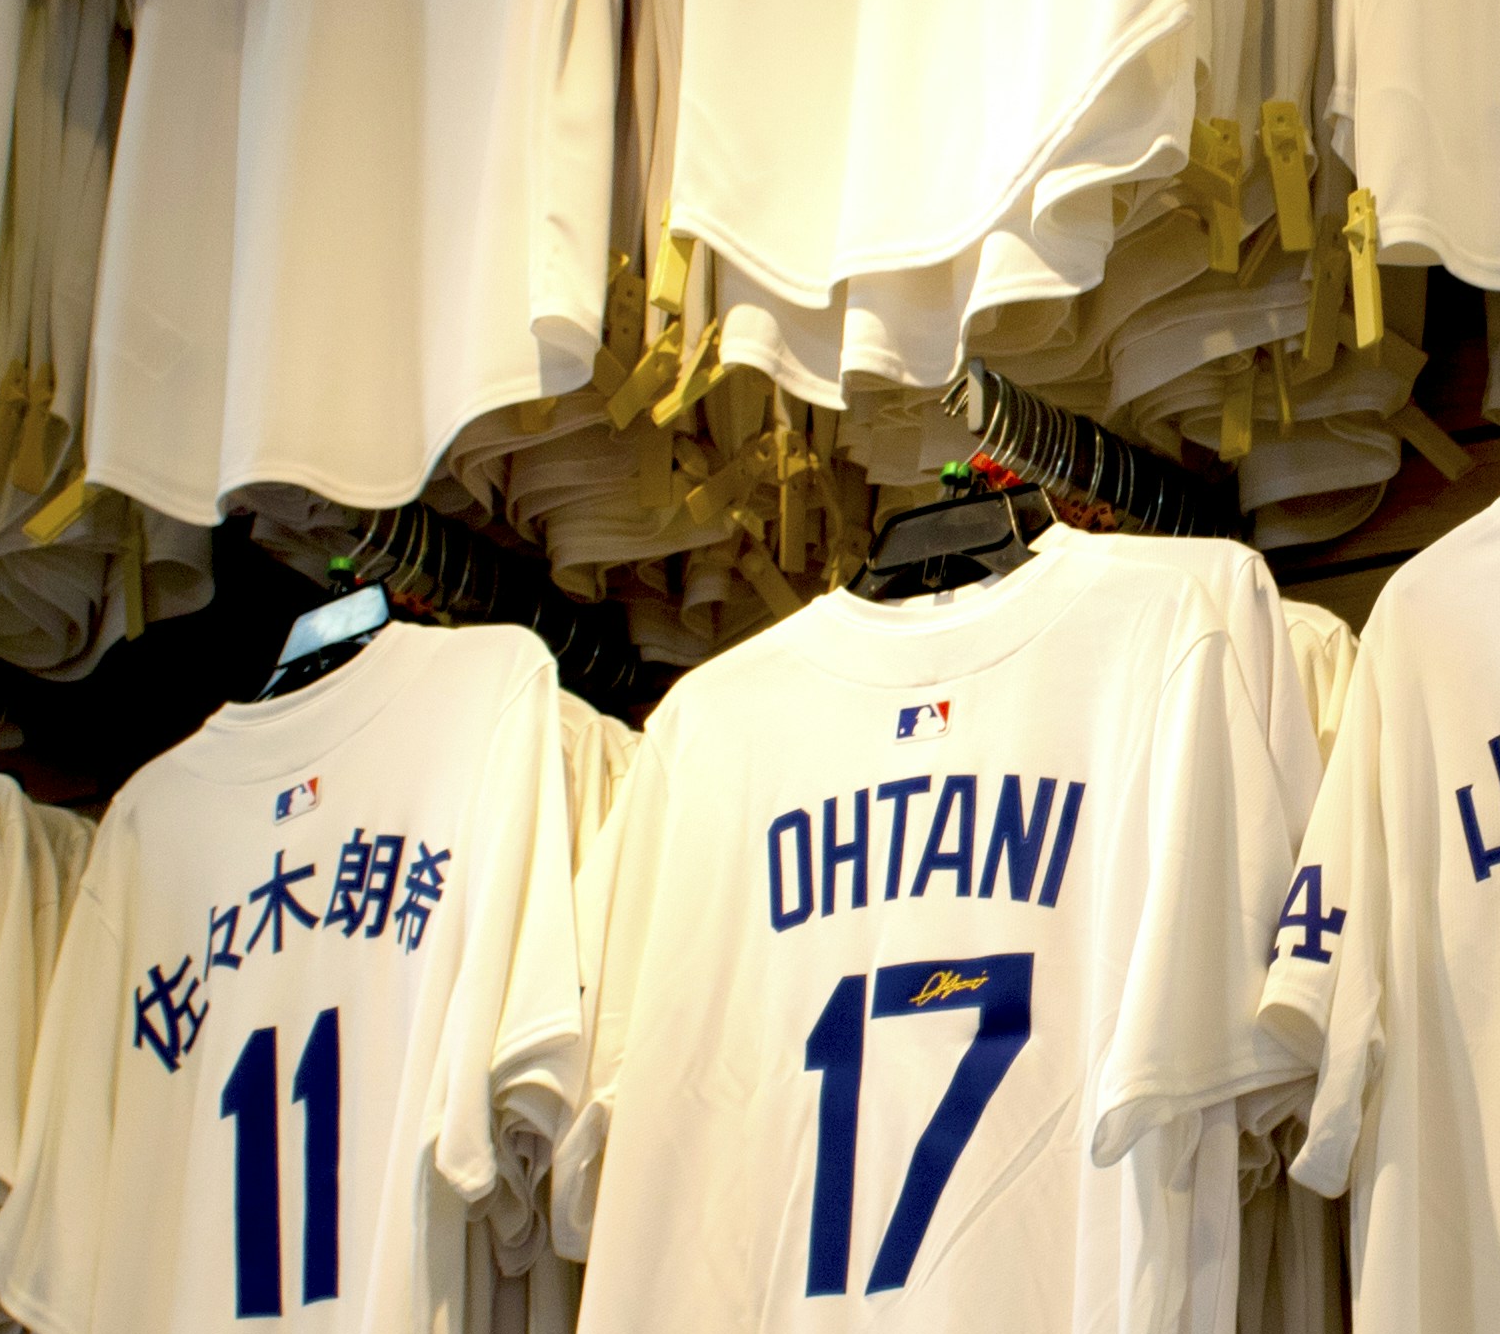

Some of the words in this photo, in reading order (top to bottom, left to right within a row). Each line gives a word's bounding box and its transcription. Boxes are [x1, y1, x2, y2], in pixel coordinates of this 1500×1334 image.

[133, 827, 452, 1074] 佐々木朗希
[768, 774, 1086, 934] OHTANI
[220, 1007, 341, 1319] 11
[804, 952, 1035, 1299] 17
